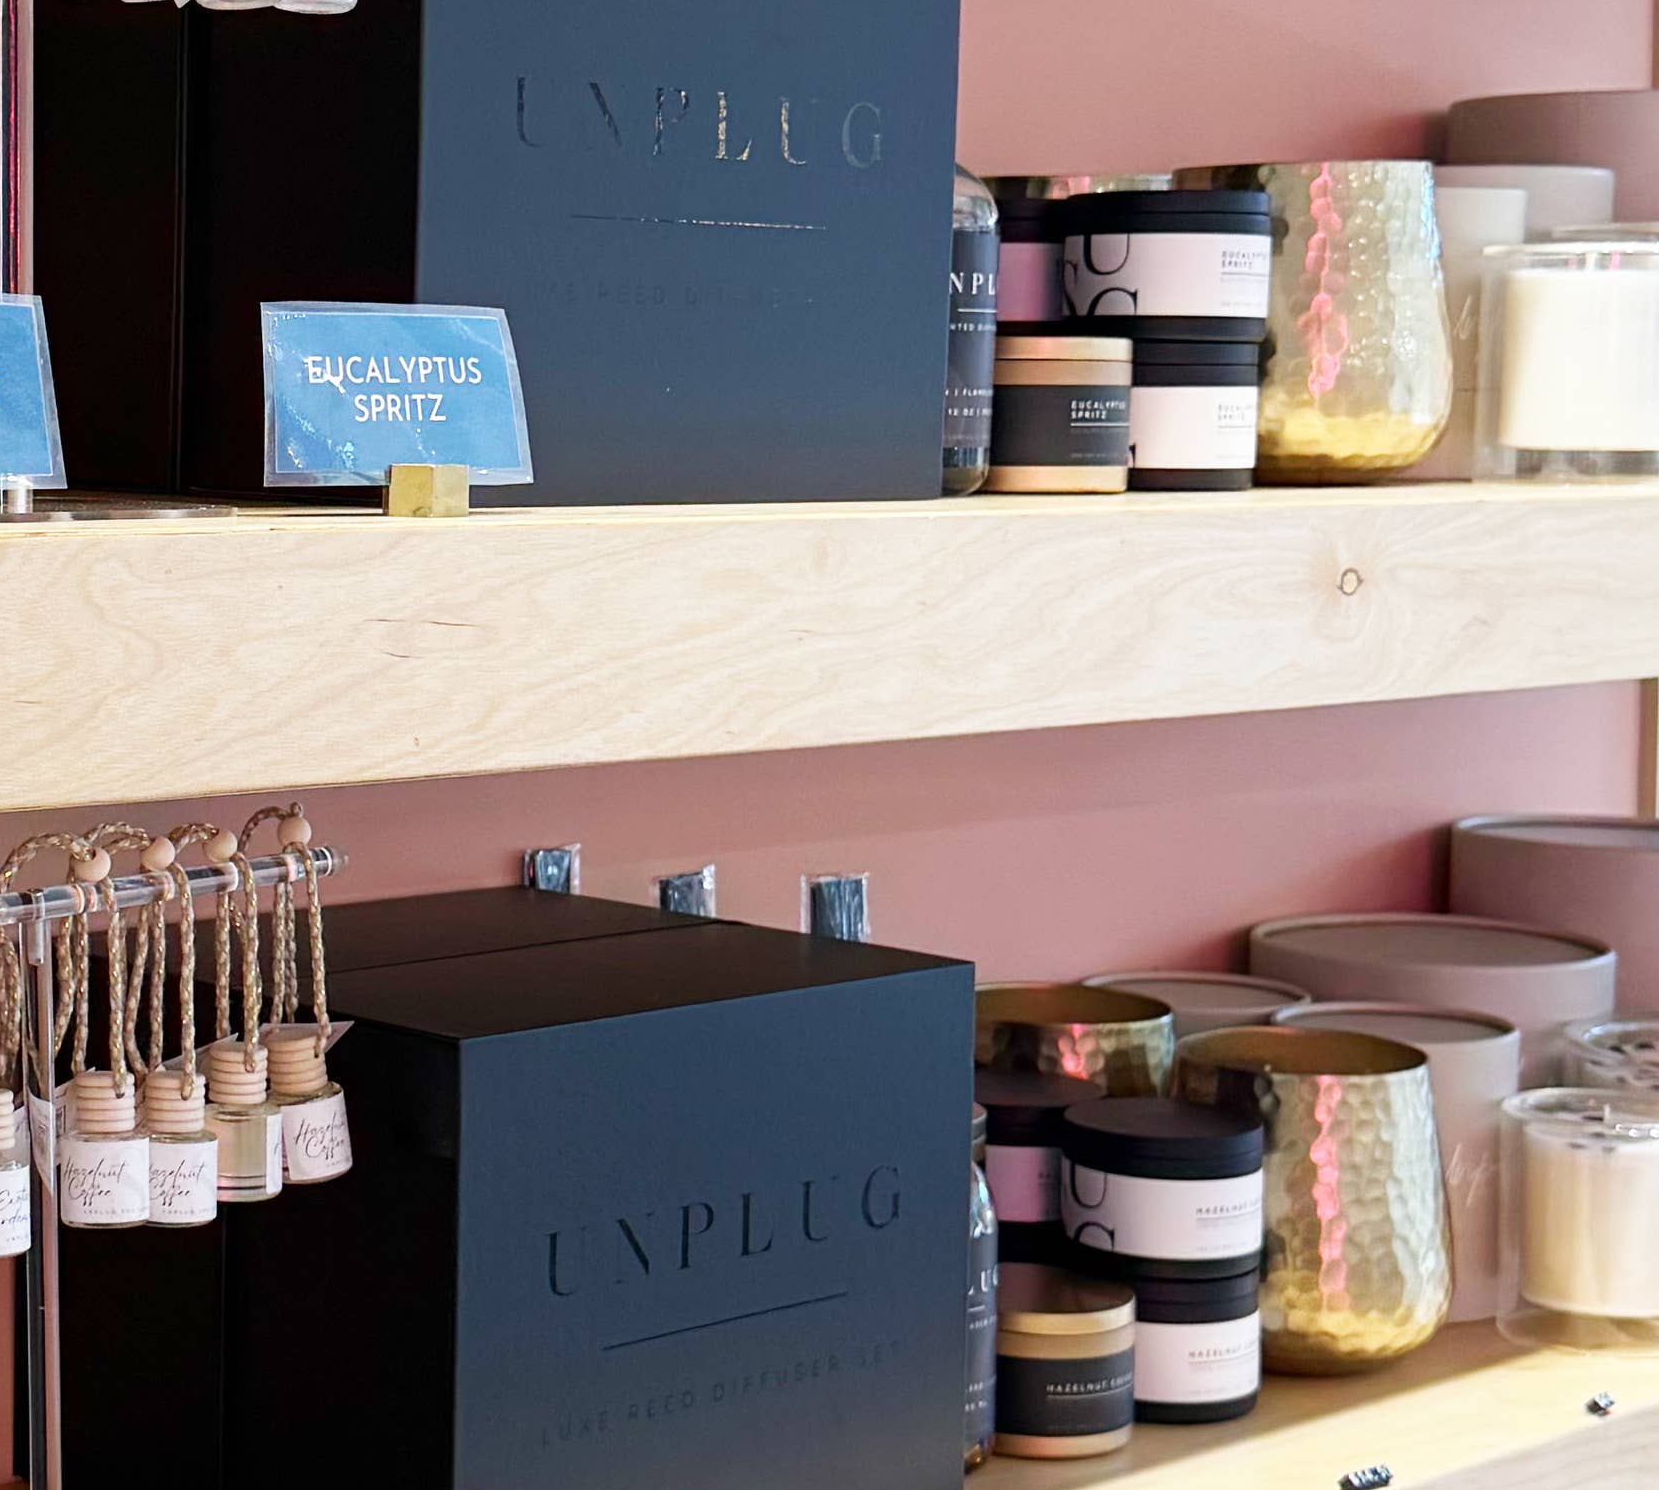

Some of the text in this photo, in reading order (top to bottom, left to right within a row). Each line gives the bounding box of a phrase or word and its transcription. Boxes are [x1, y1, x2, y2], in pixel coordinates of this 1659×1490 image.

[515, 74, 883, 168] UNPLUG
[948, 272, 996, 296] NPL
[306, 356, 482, 385] EUCALYPTUS
[354, 393, 447, 423] SPRITZ
[62, 1157, 127, 1186] Hazelnut
[148, 1158, 206, 1188] azelnut
[68, 1176, 111, 1207] Coffee
[545, 1164, 901, 1297] UNPLUG
[627, 1388, 696, 1421] REED
[711, 1353, 841, 1403] DIFFUSER
